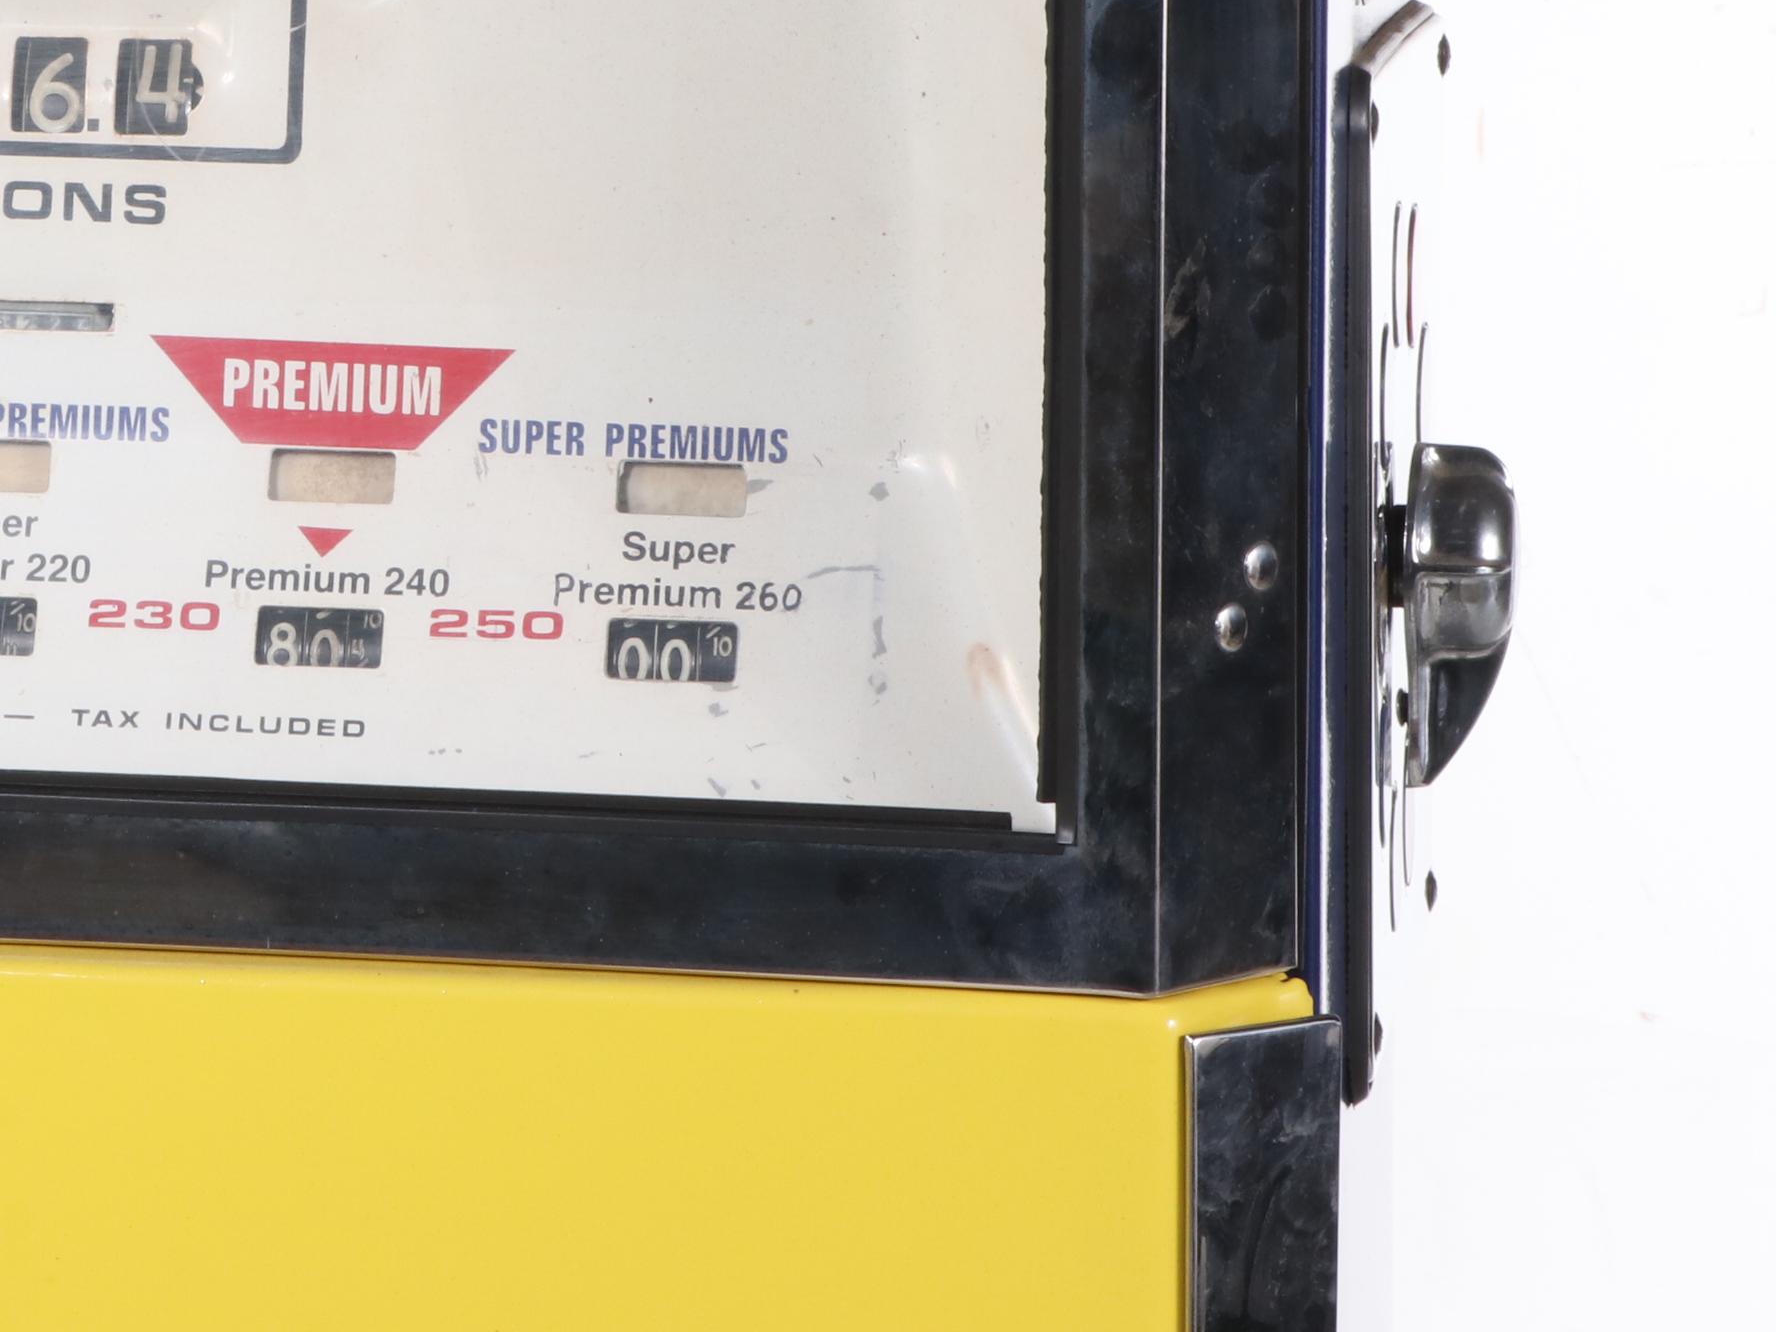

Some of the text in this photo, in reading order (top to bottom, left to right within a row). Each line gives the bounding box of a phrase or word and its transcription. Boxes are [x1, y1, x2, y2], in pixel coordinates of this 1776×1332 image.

[224, 358, 443, 417] PREMIUM
[478, 418, 789, 464] SUPER PREMIUMS
[622, 531, 736, 566] Super
[26, 555, 91, 584] 220
[204, 559, 450, 598] Premium 240
[554, 573, 803, 613] Premium 260
[88, 599, 220, 632] 230
[429, 609, 564, 640] 250
[72, 708, 140, 730] TAX
[166, 713, 366, 739] INCLUDED
